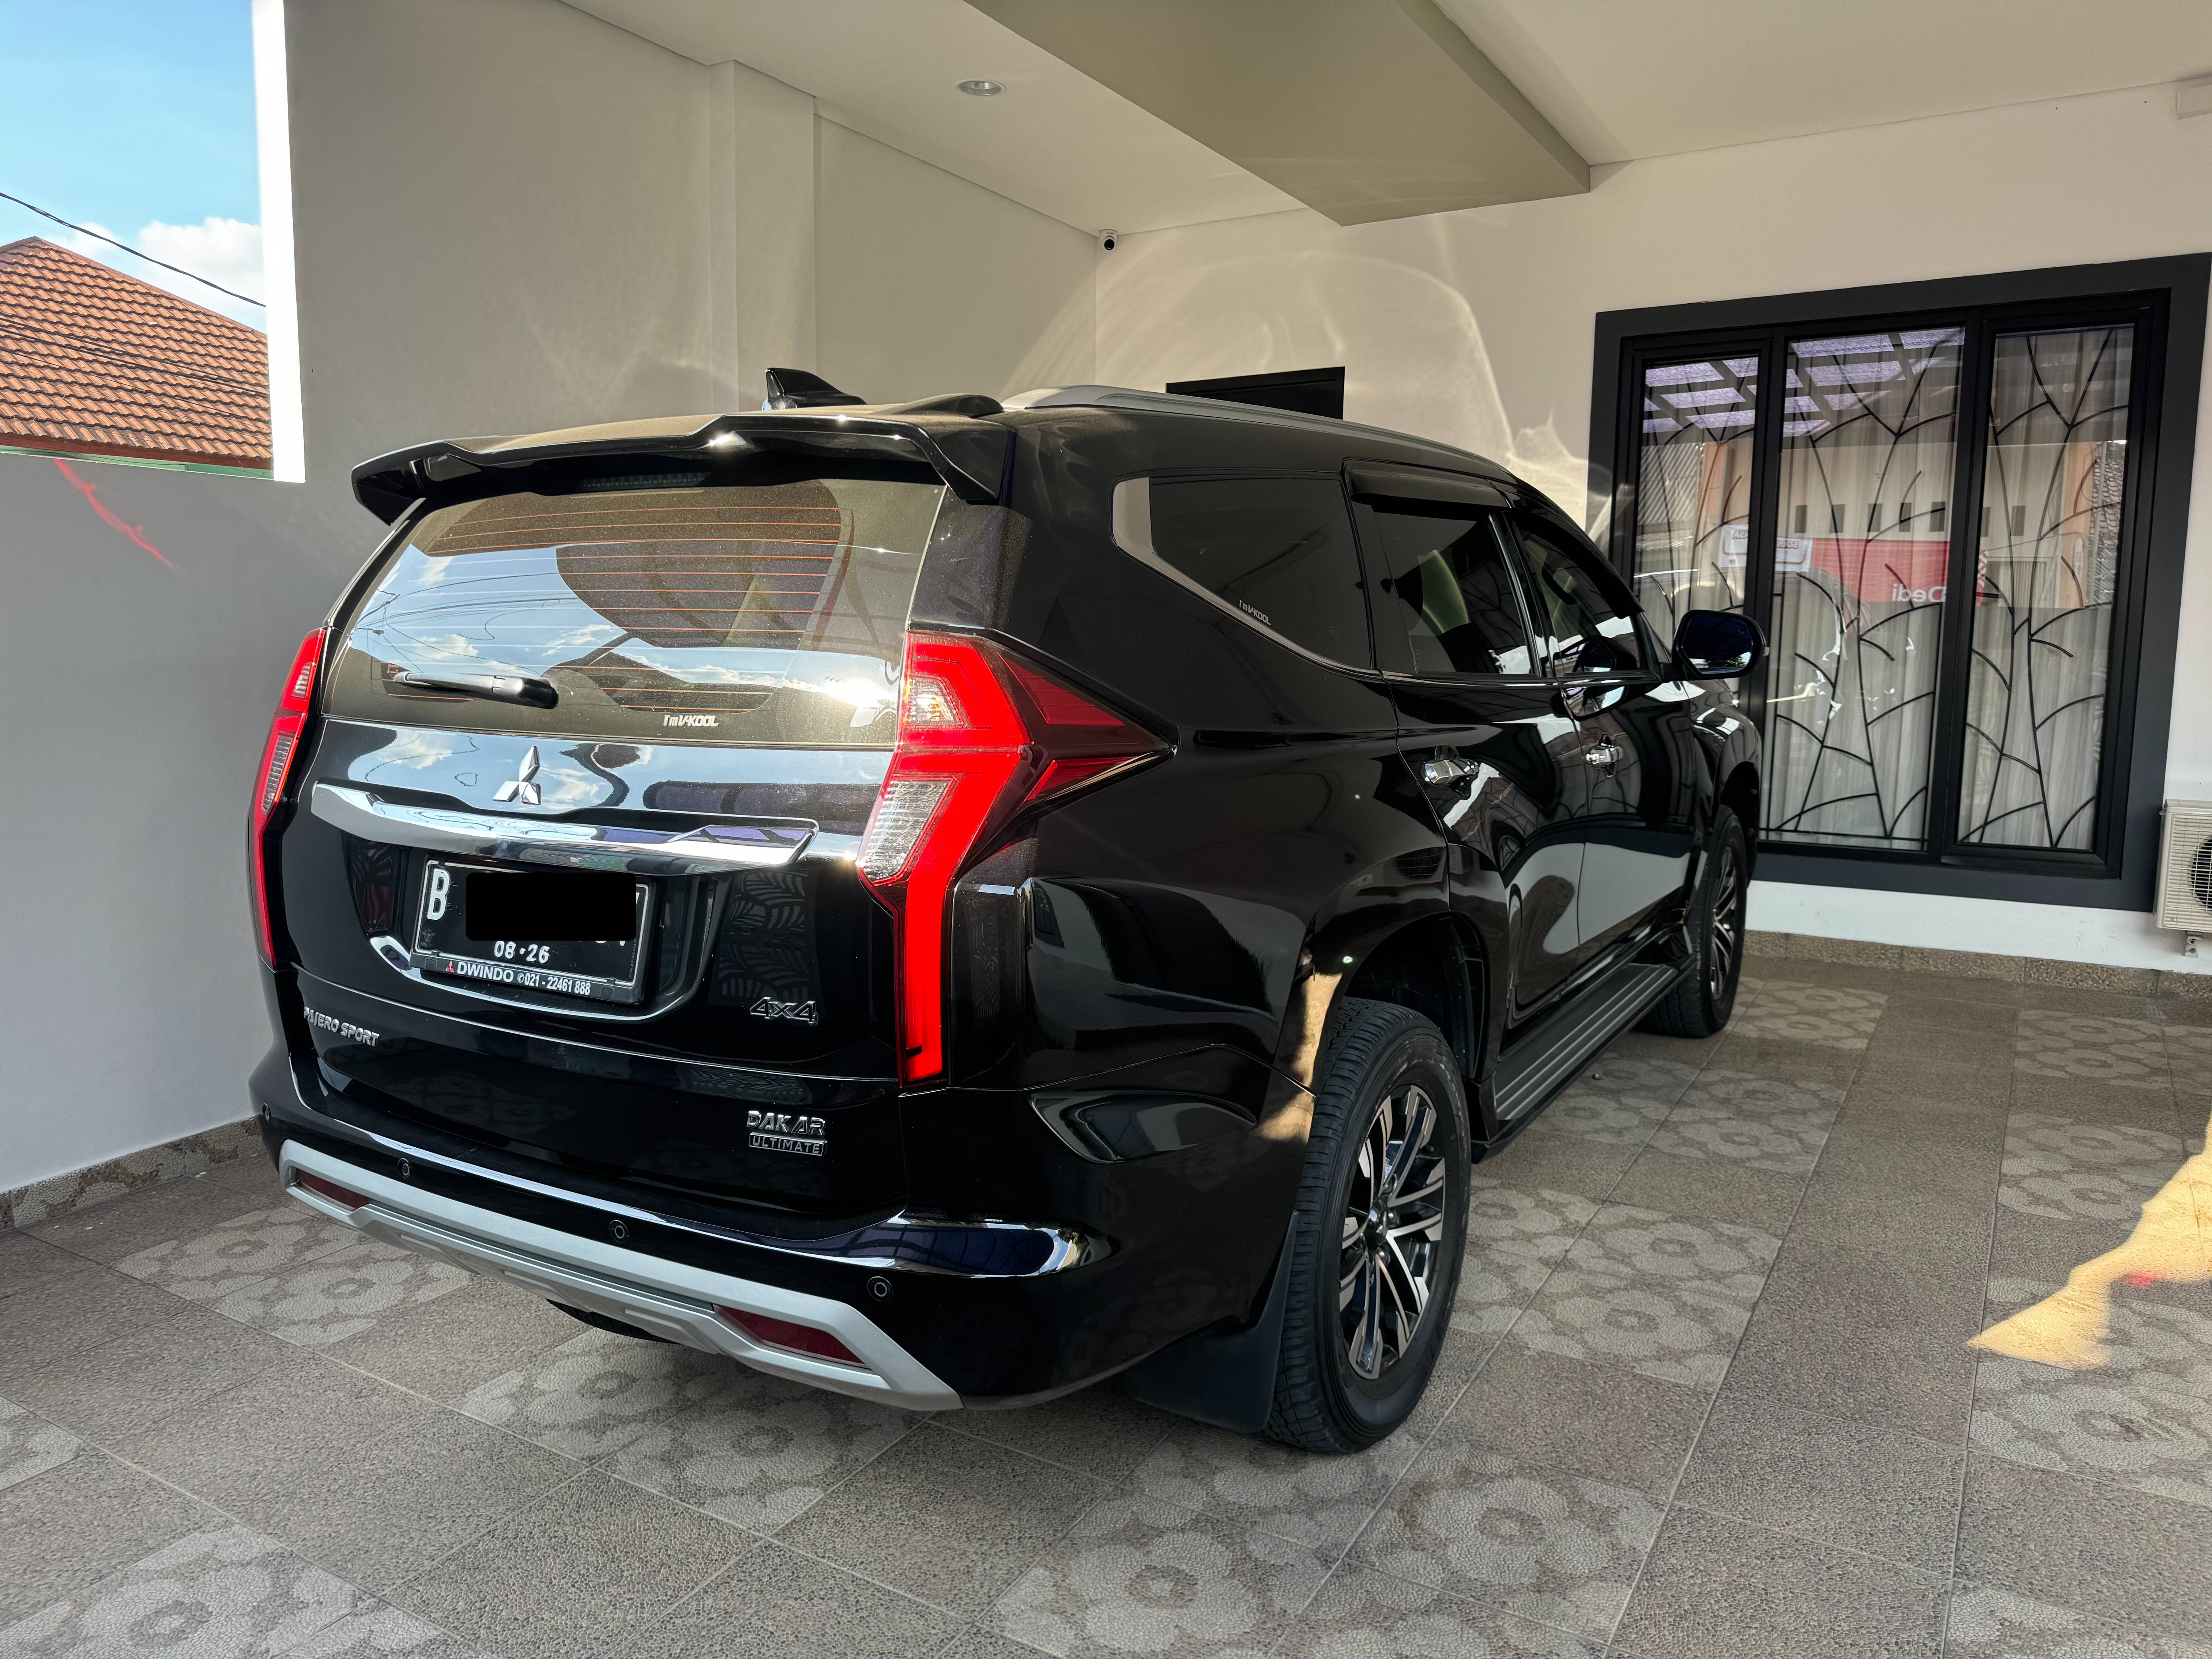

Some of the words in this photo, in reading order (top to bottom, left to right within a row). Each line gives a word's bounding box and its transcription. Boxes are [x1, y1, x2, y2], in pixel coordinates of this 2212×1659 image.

[427, 868, 450, 920] B
[457, 962, 514, 982] DWINDO
[546, 976, 572, 993] 22461
[574, 980, 591, 995] 888
[304, 1006, 340, 1032] PAJERO
[340, 1022, 380, 1047] SPORT
[747, 1110, 826, 1135] DAKAR
[752, 1135, 820, 1154] ULTIMATE
